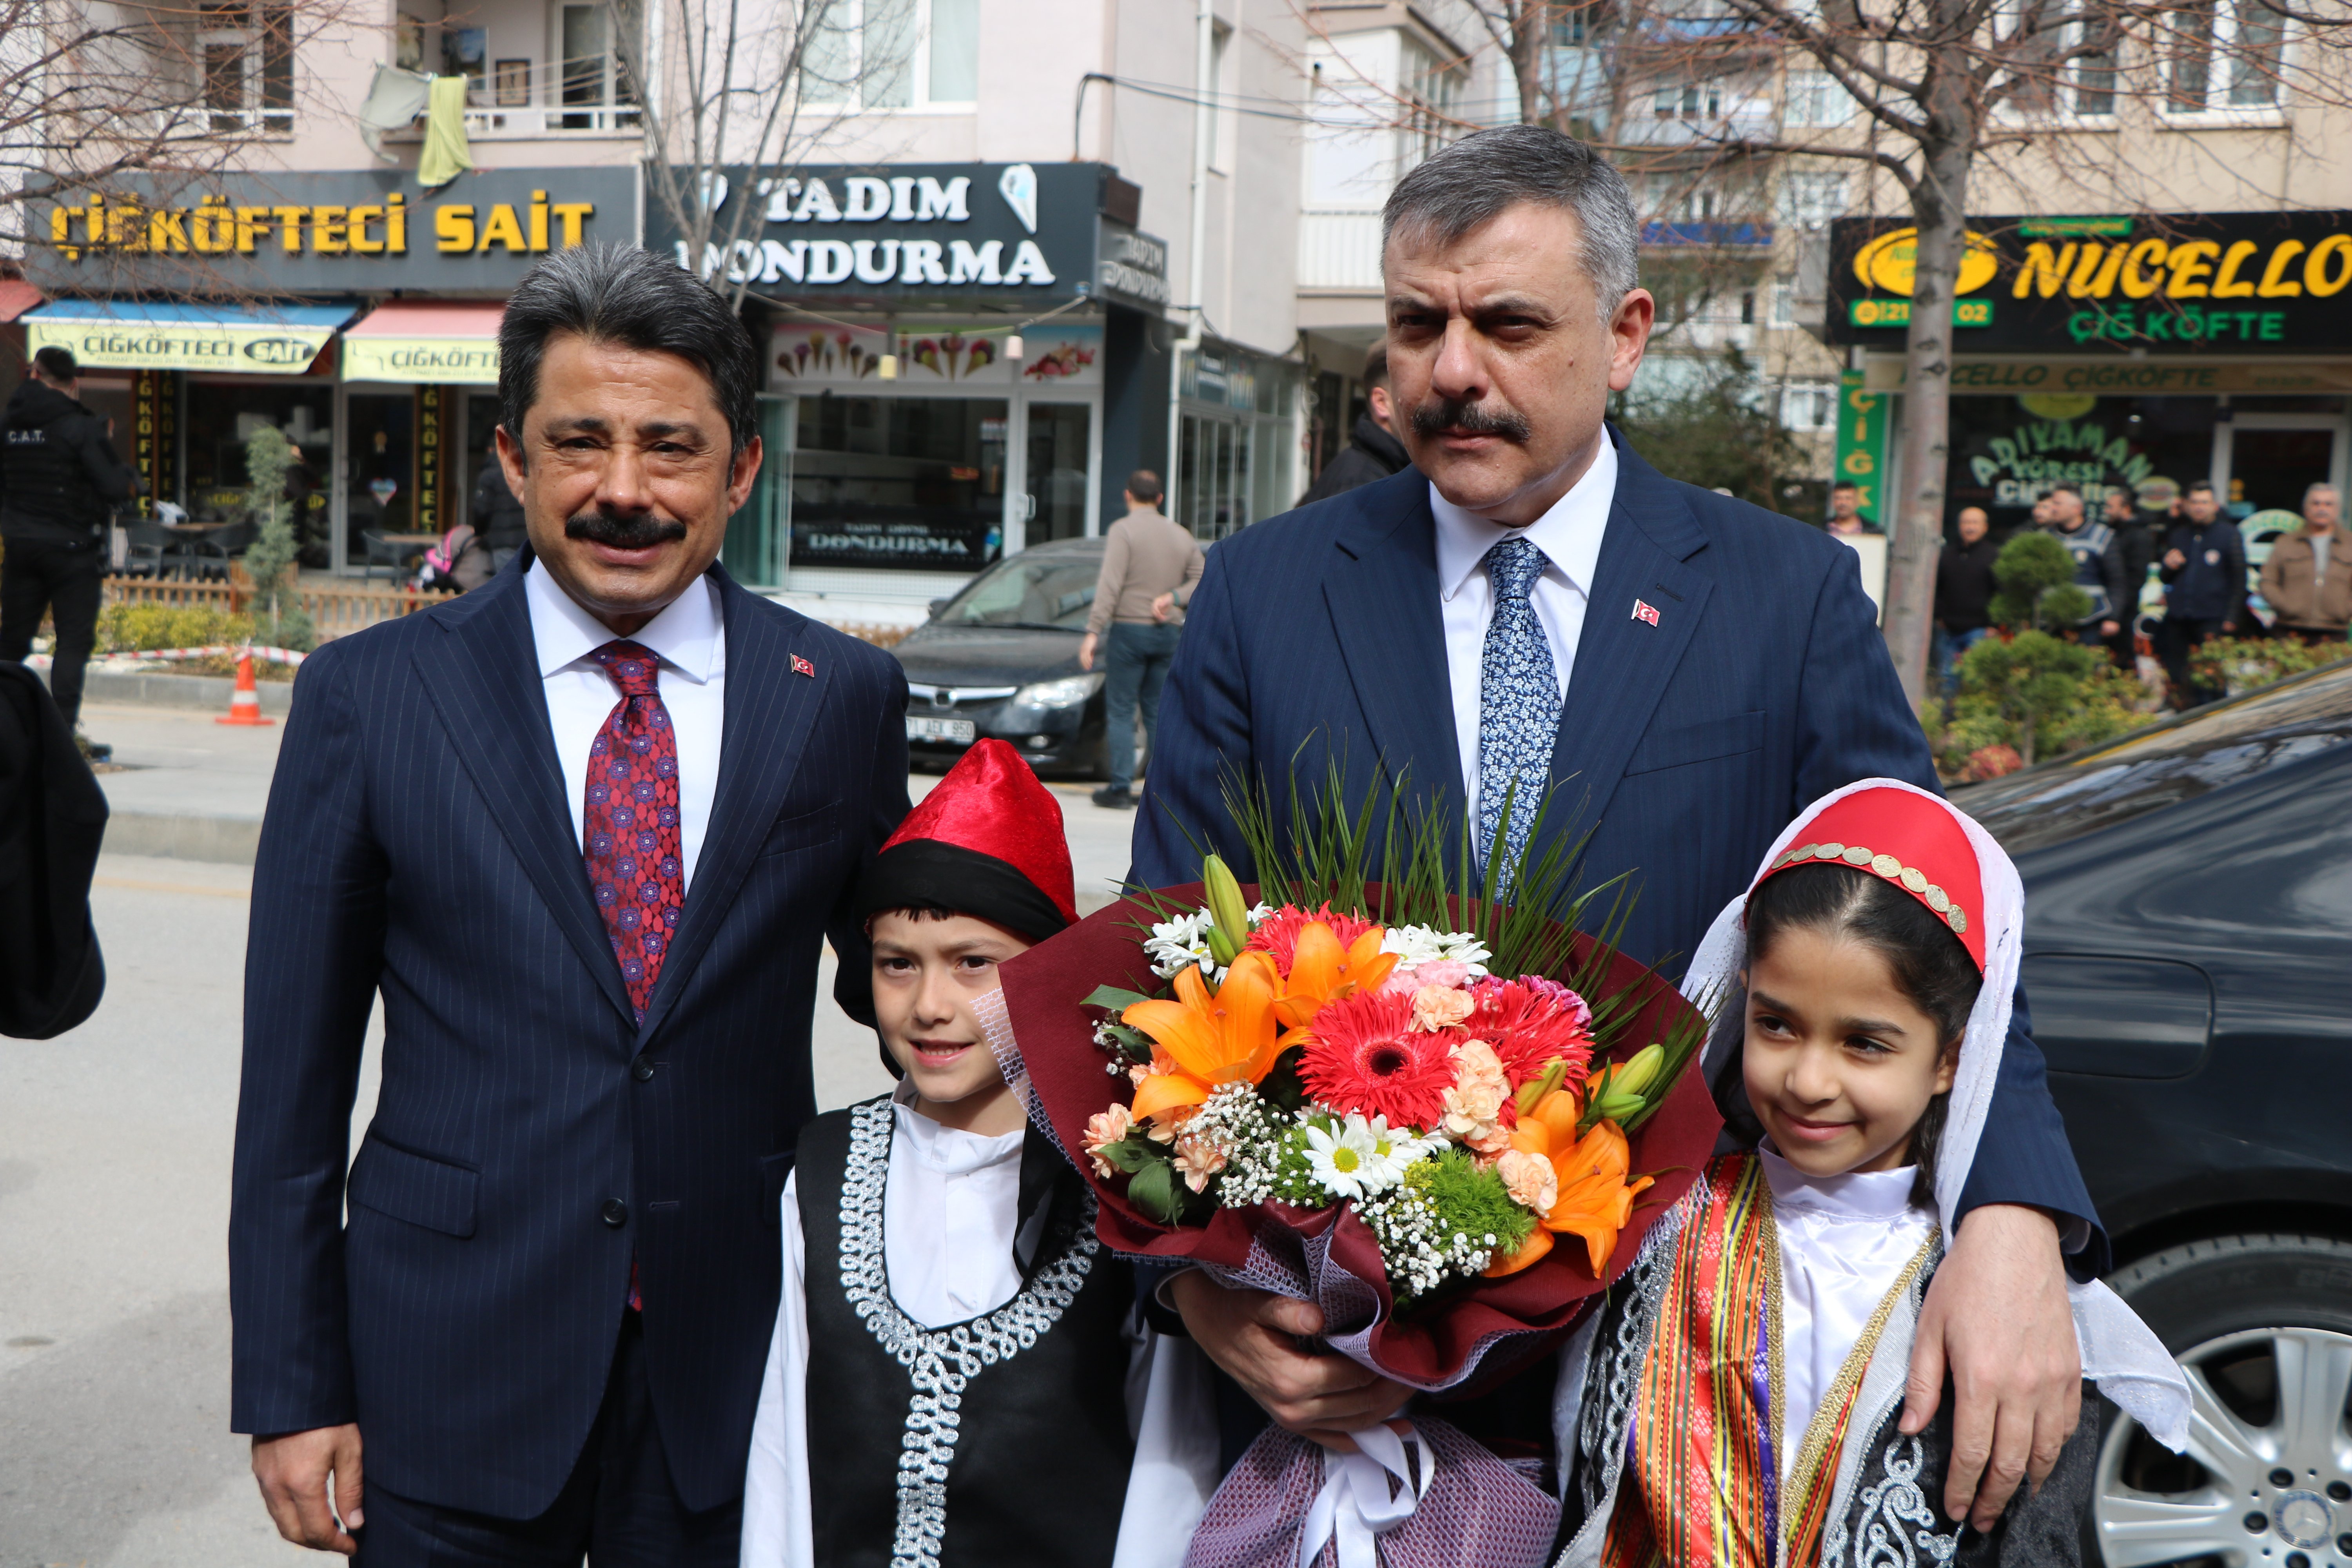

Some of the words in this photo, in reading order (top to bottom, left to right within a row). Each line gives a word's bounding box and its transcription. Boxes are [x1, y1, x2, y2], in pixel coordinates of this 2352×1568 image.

[757, 177, 971, 222] TADIM
[52, 192, 406, 261] ÇİĞKÖFTECİ
[435, 189, 593, 252] SAİT
[673, 240, 1056, 285] DONDURMA
[2012, 234, 2352, 299] NUCELLO
[2145, 305, 2286, 341] KÖFTE
[84, 332, 235, 356] ÇİĞKÖFTECİ
[255, 339, 308, 363] SAİT
[808, 533, 969, 555] DONDURMA
[953, 721, 972, 736] 950
